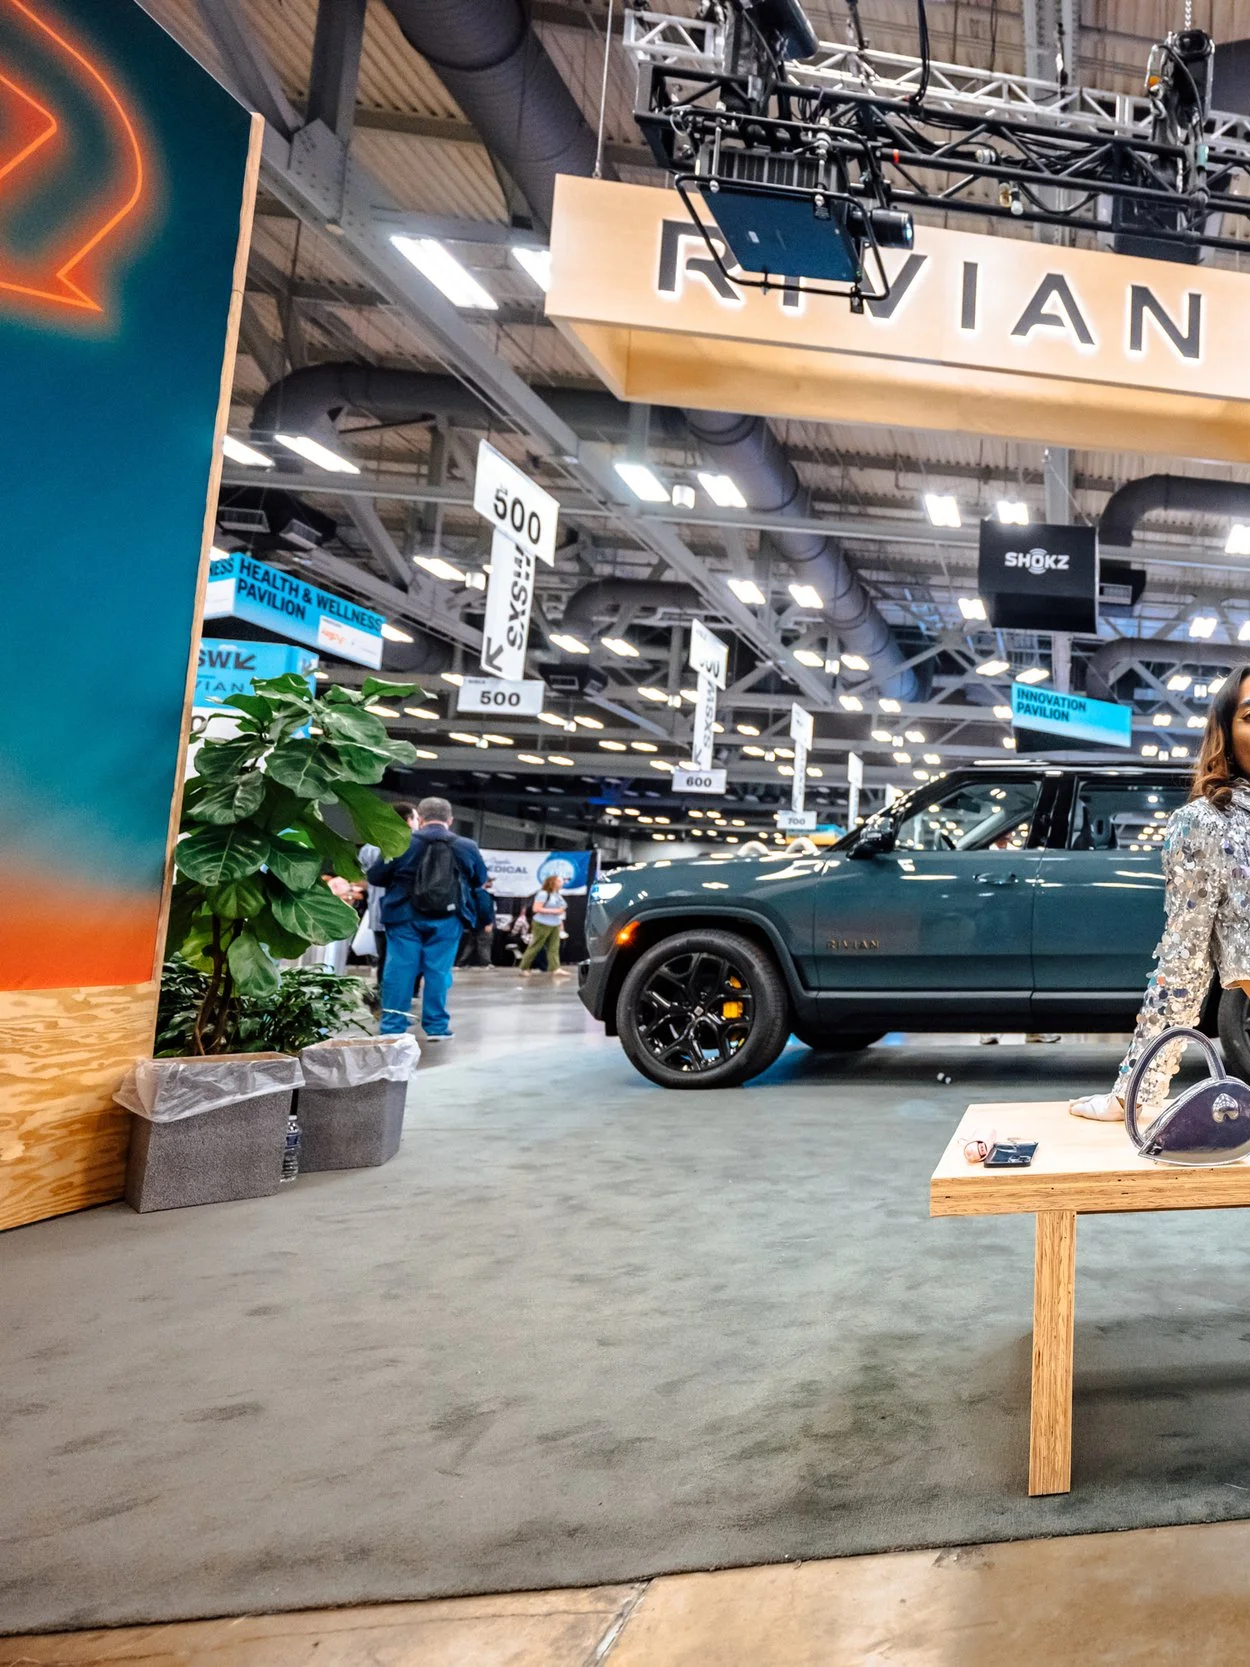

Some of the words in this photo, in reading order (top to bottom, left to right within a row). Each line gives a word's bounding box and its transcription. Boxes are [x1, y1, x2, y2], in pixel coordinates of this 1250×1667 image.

[493, 488, 541, 545] 500
[1004, 552, 1069, 570] SHOKZ
[237, 578, 306, 620] PAVILION
[239, 556, 300, 598] HEALTH
[302, 587, 313, 604] &
[316, 594, 383, 632] WELLNESS
[480, 691, 520, 706] 500
[1017, 688, 1087, 712] INNOVATION
[1017, 702, 1069, 722] PAVILION
[686, 777, 712, 788] 600
[487, 865, 528, 874] EDICAL
